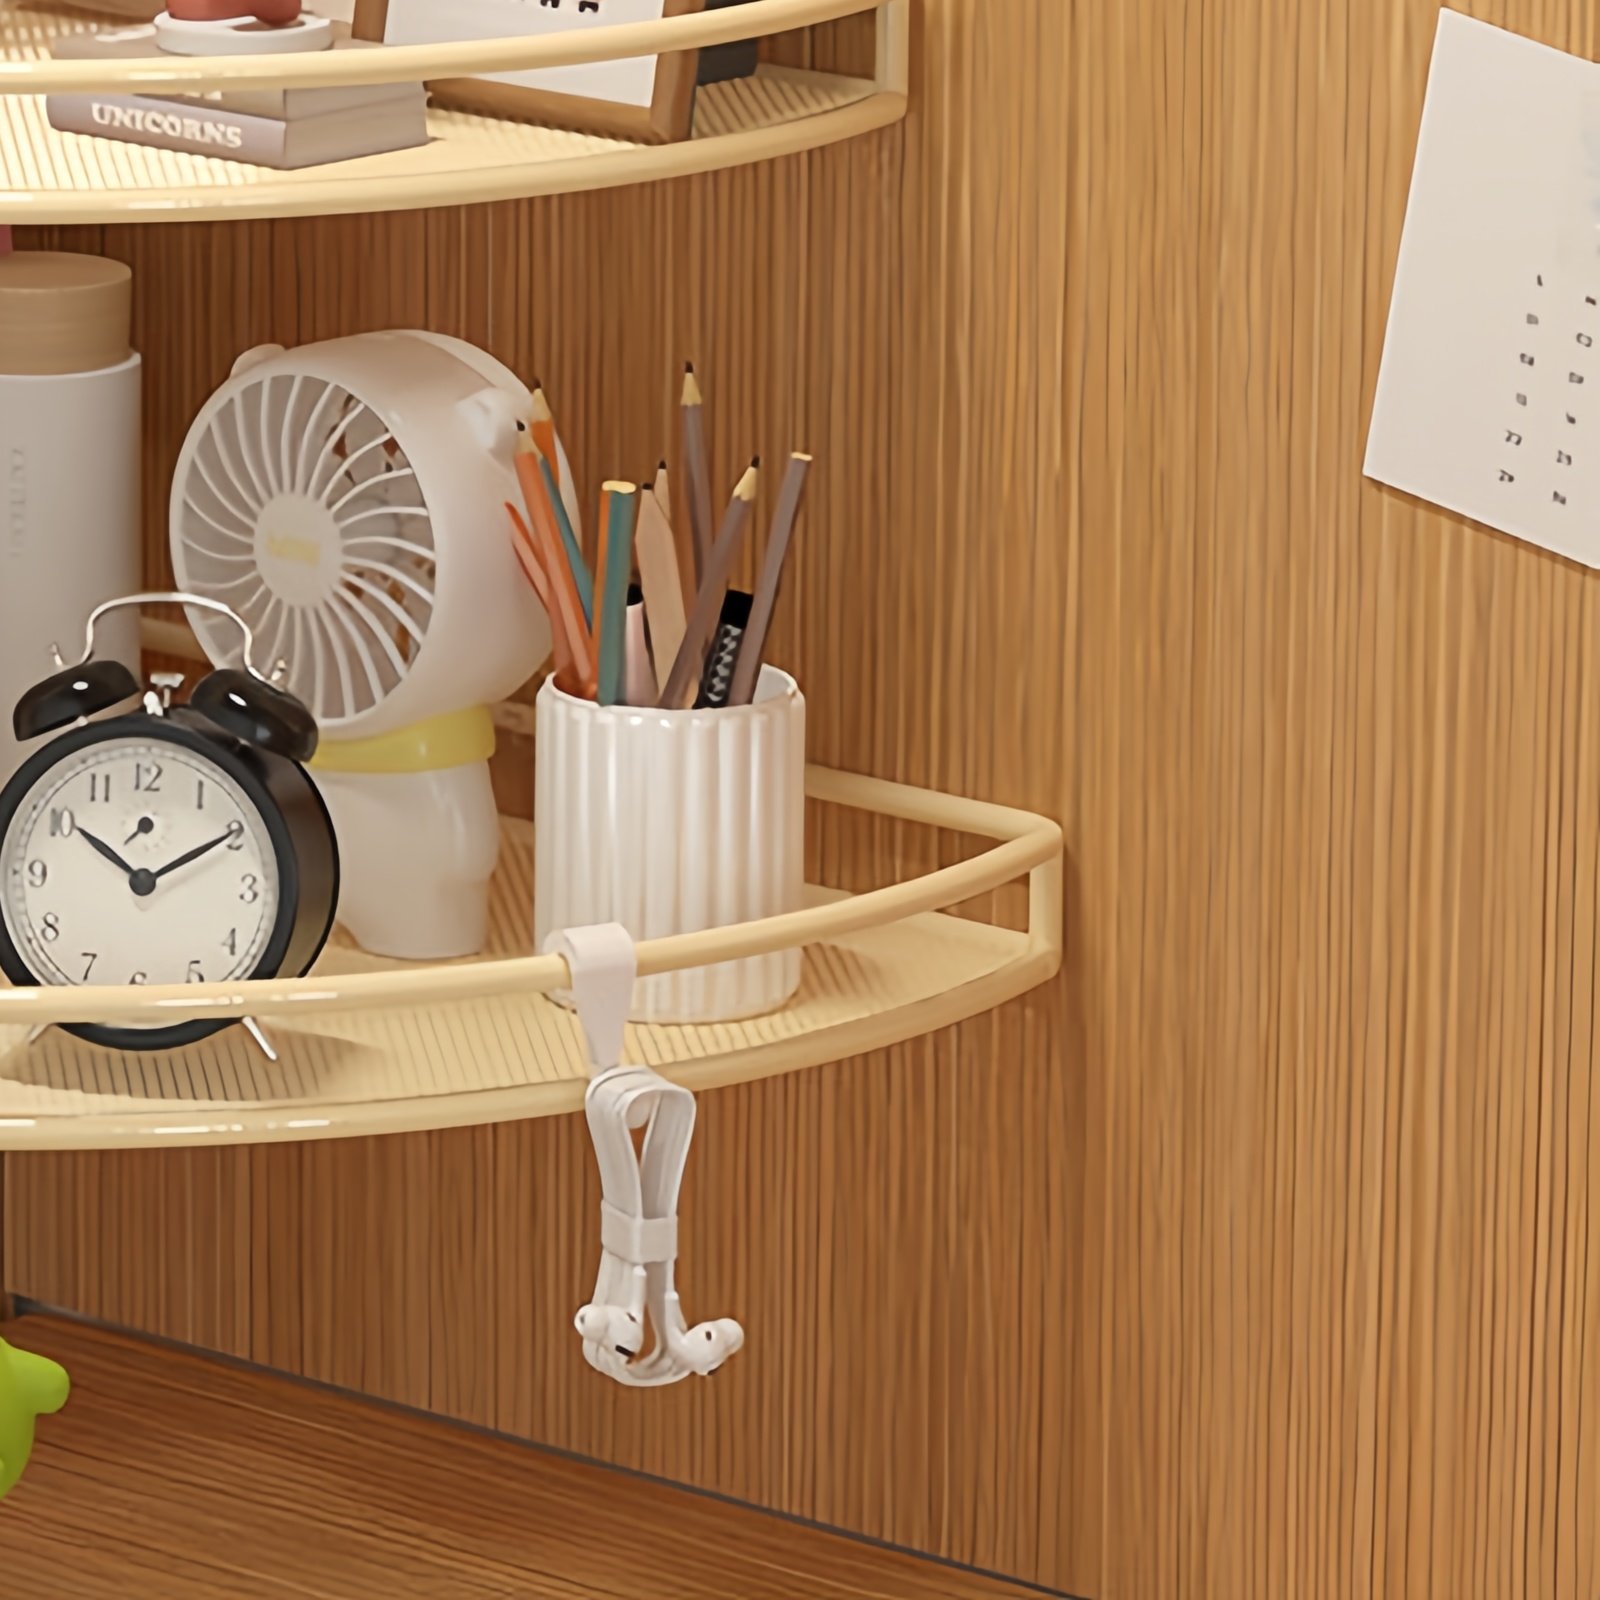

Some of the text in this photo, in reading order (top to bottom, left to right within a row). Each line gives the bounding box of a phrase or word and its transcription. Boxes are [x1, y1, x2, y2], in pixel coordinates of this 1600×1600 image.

[91, 102, 242, 148] UNICORNS
[90, 773, 110, 803] 11
[134, 762, 163, 792] 12
[197, 779, 204, 810] 1
[50, 807, 75, 837] 10
[226, 820, 244, 851] 2
[28, 860, 48, 888] 9
[239, 873, 258, 904] 3
[40, 912, 60, 942] 8
[220, 928, 237, 956] 4
[81, 952, 98, 981] 7
[185, 960, 205, 984] 5
